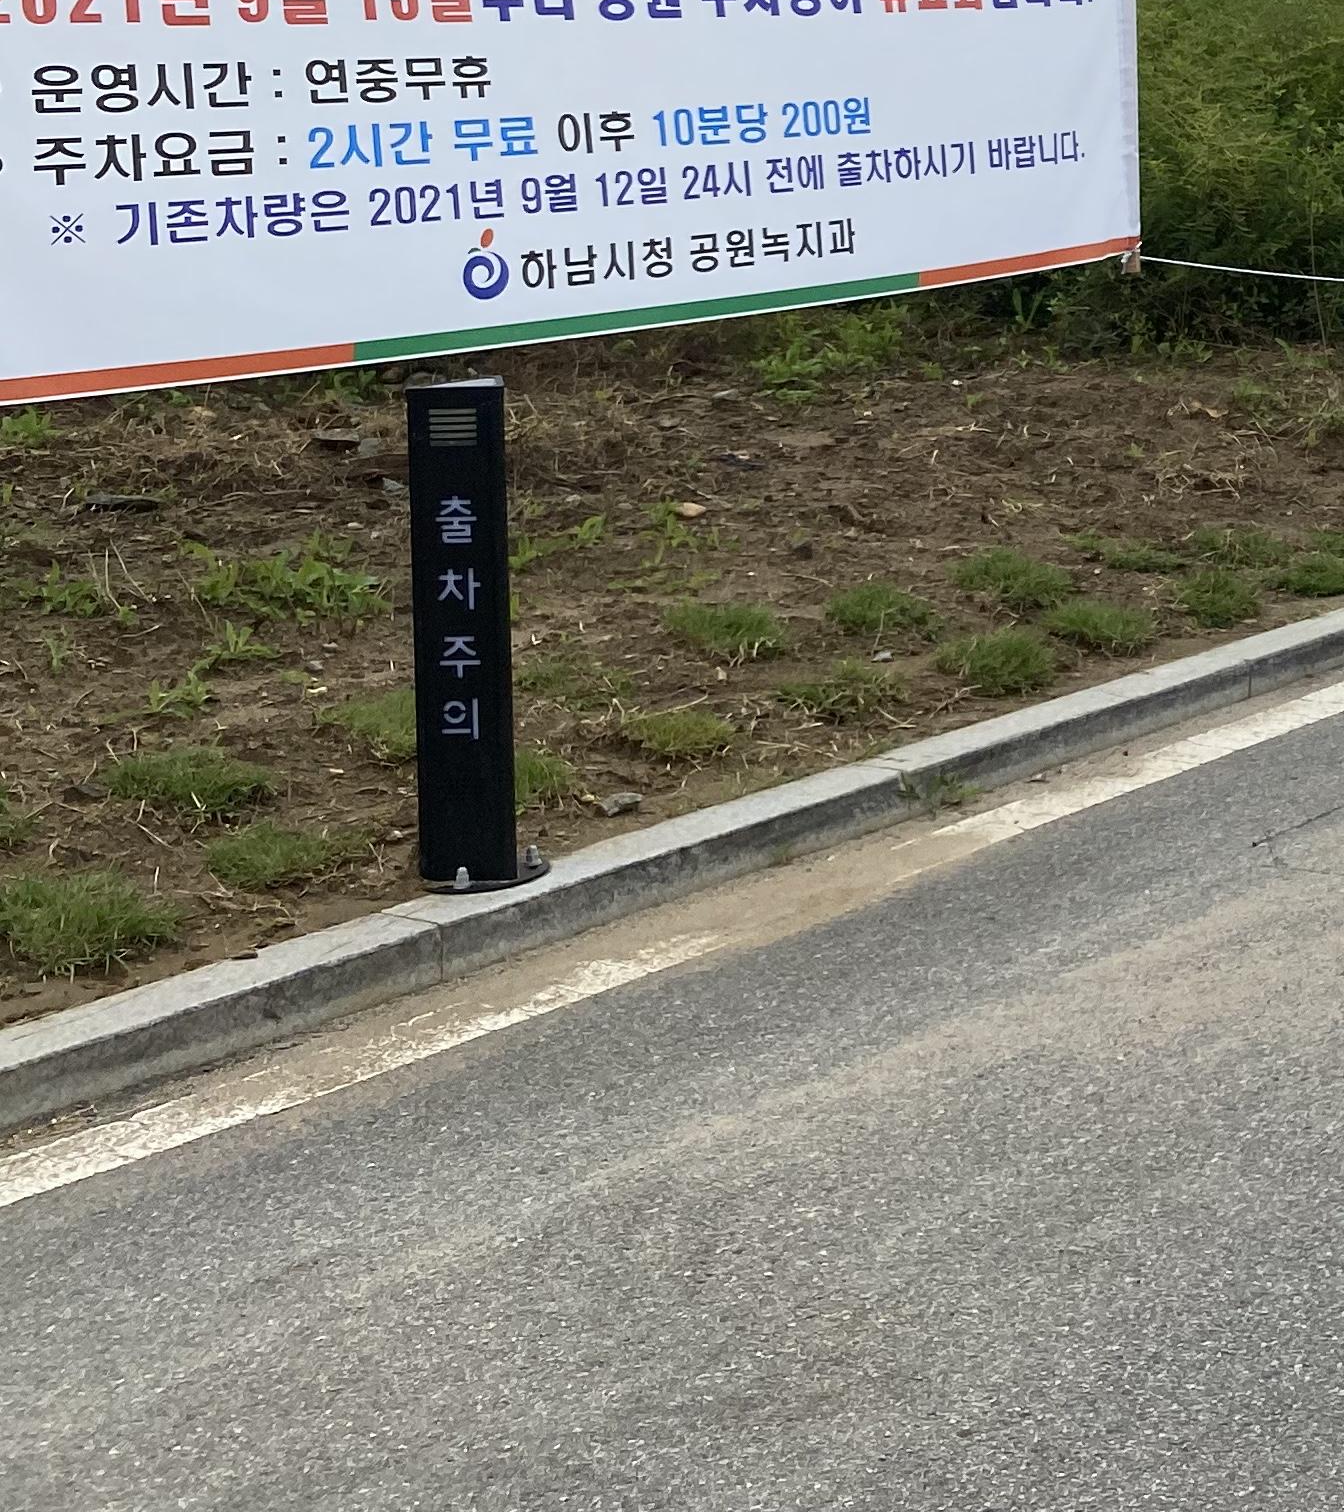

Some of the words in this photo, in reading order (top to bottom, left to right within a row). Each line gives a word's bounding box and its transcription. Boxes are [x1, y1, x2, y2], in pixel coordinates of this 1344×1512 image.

[32, 62, 252, 113] 운영시간
[306, 56, 491, 104] 연중무휴
[34, 130, 254, 185] 주차요금
[308, 121, 432, 169] 2시간
[454, 117, 538, 161] 무료
[558, 111, 634, 154] 이후
[653, 104, 768, 146] 10분당
[782, 97, 871, 138] 200원
[116, 191, 349, 245] 기존차량은
[369, 179, 504, 226] 2021년
[521, 174, 578, 214] 9월
[595, 168, 667, 207] 12일
[682, 161, 751, 200] 24시
[766, 155, 824, 193] 전에
[838, 142, 975, 187] 출차하시기
[988, 131, 1084, 170] 바랍니다.
[521, 237, 672, 289] 하남시청
[690, 218, 855, 272] 공원녹지과
[435, 495, 481, 741] 출차주의
